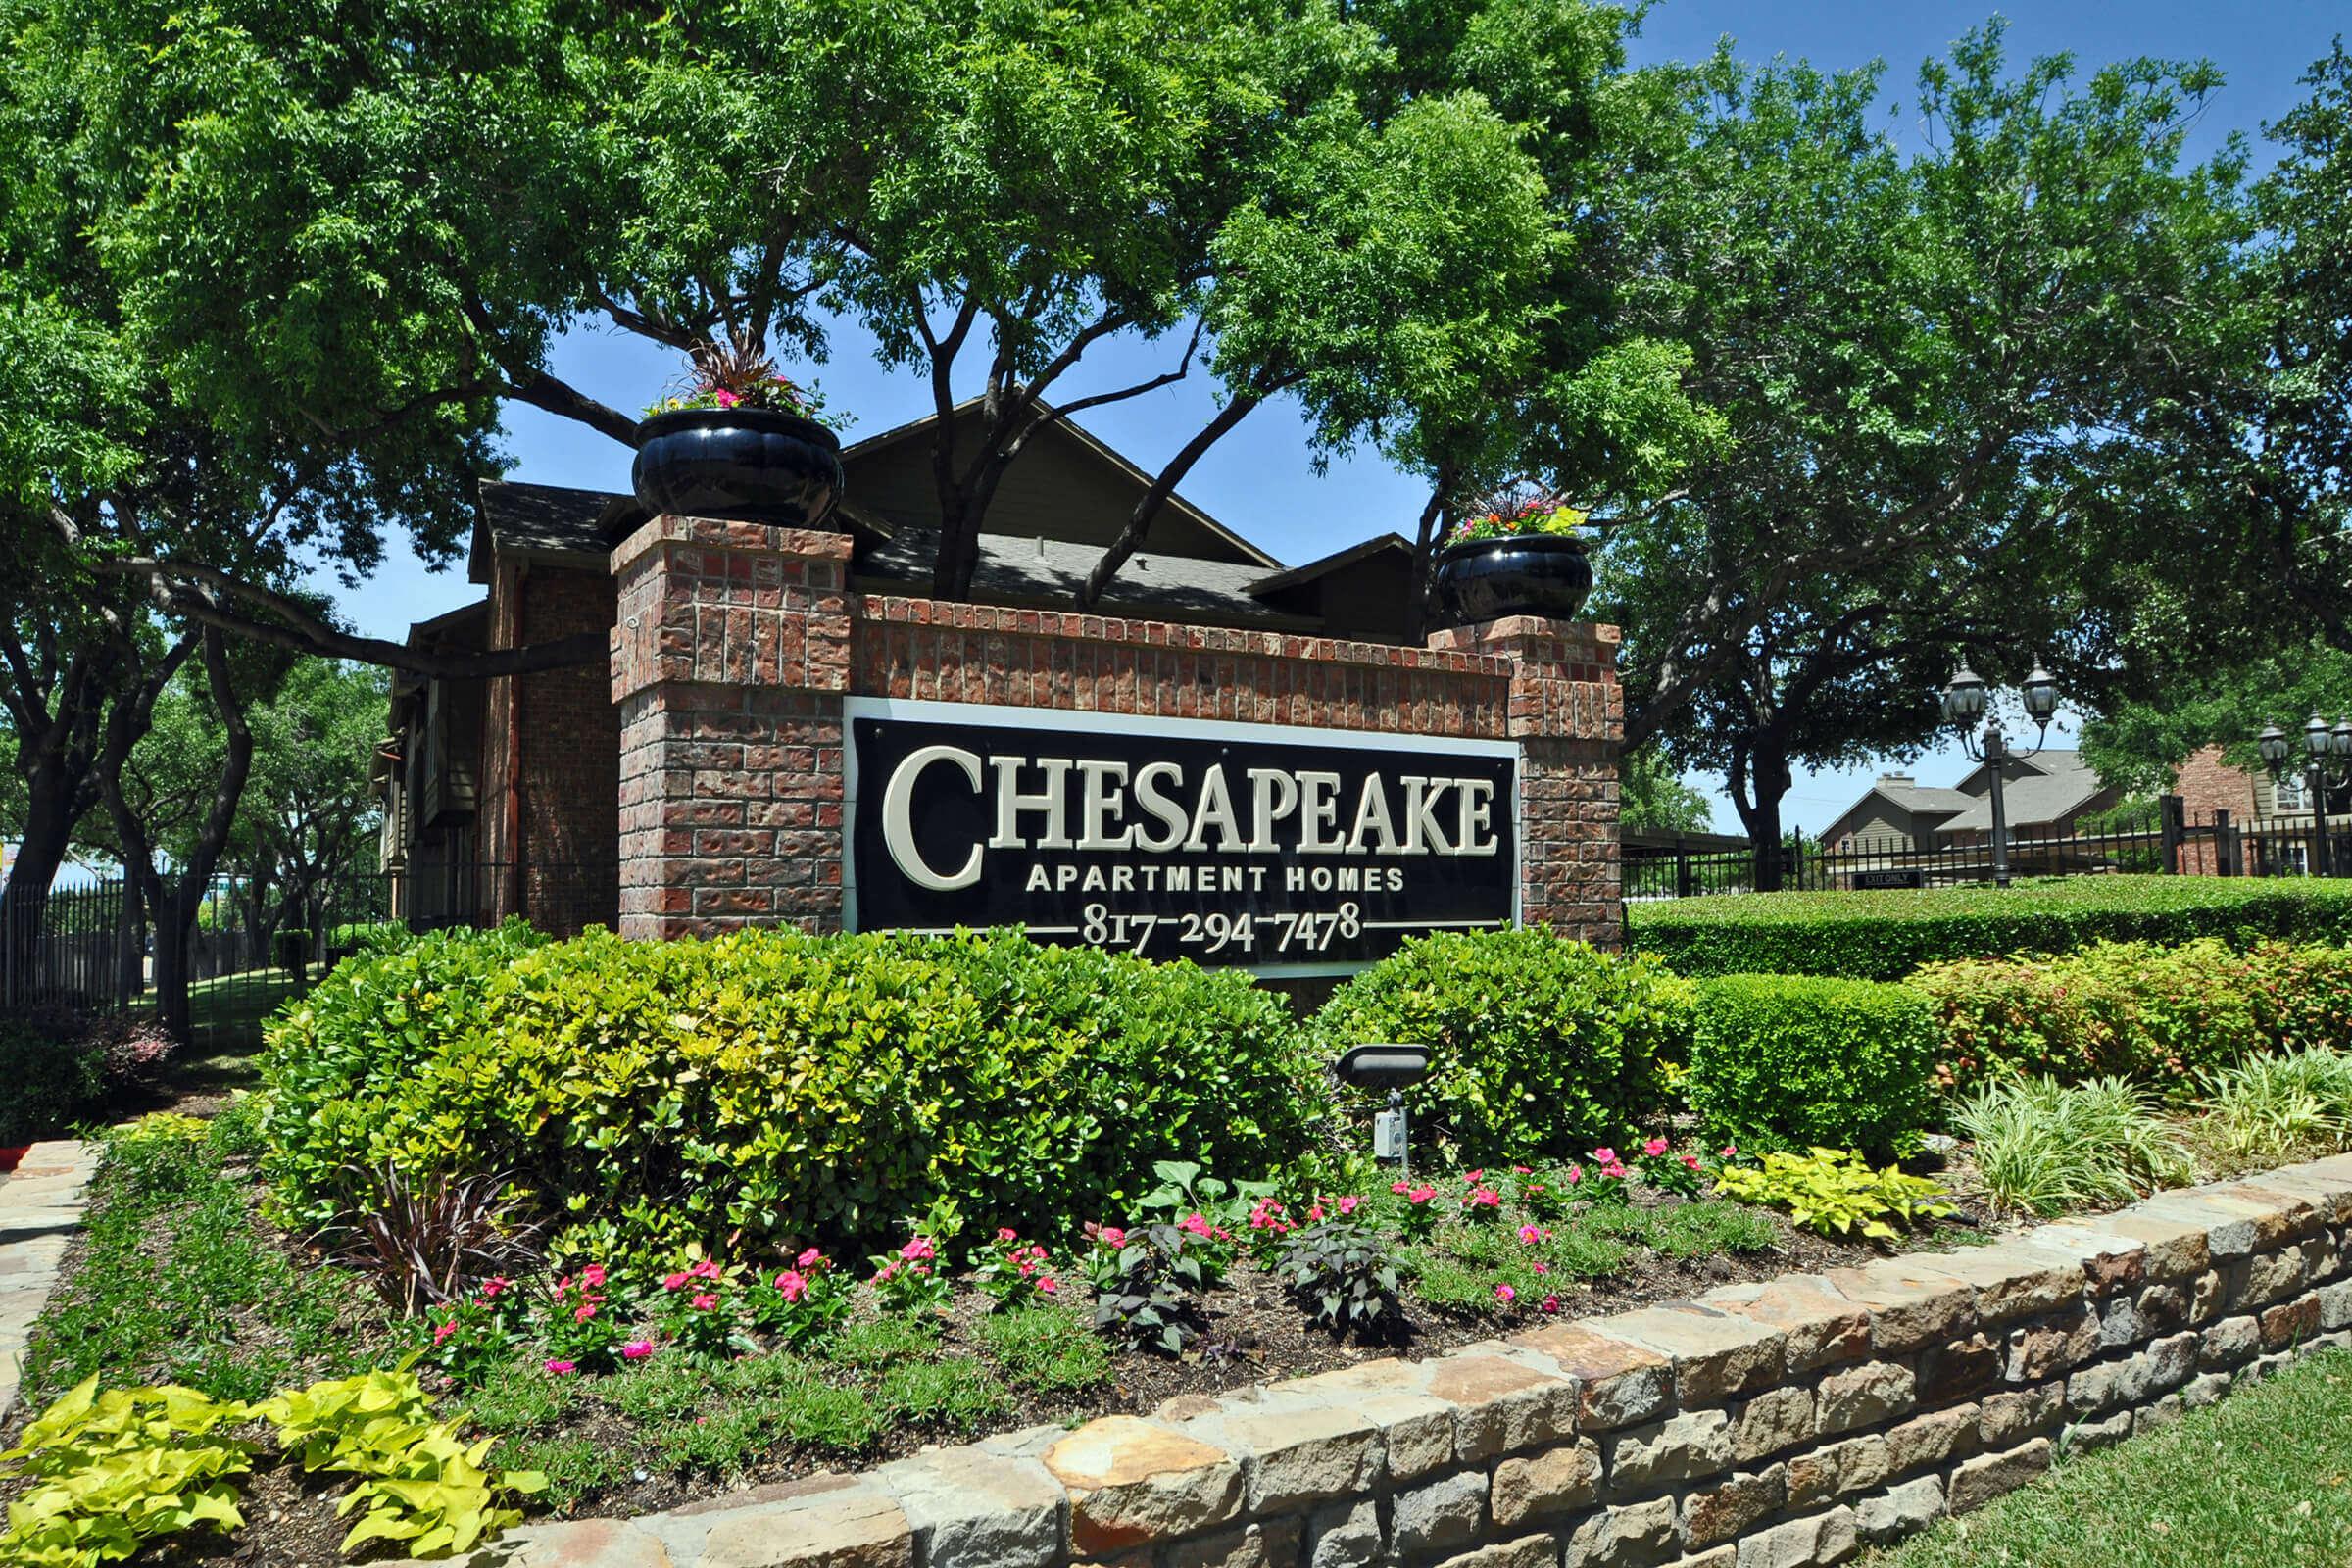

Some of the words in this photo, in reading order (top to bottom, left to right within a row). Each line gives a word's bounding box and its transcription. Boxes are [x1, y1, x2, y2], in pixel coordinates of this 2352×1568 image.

[882, 745, 1498, 891] CHESAPEAKE
[1025, 864, 1267, 892] APARTMENT
[1286, 866, 1403, 892] HOMES
[1865, 874, 1883, 883] EXIT
[1884, 873, 1908, 882] ONLY
[1083, 901, 1360, 956] 817-294-7478
